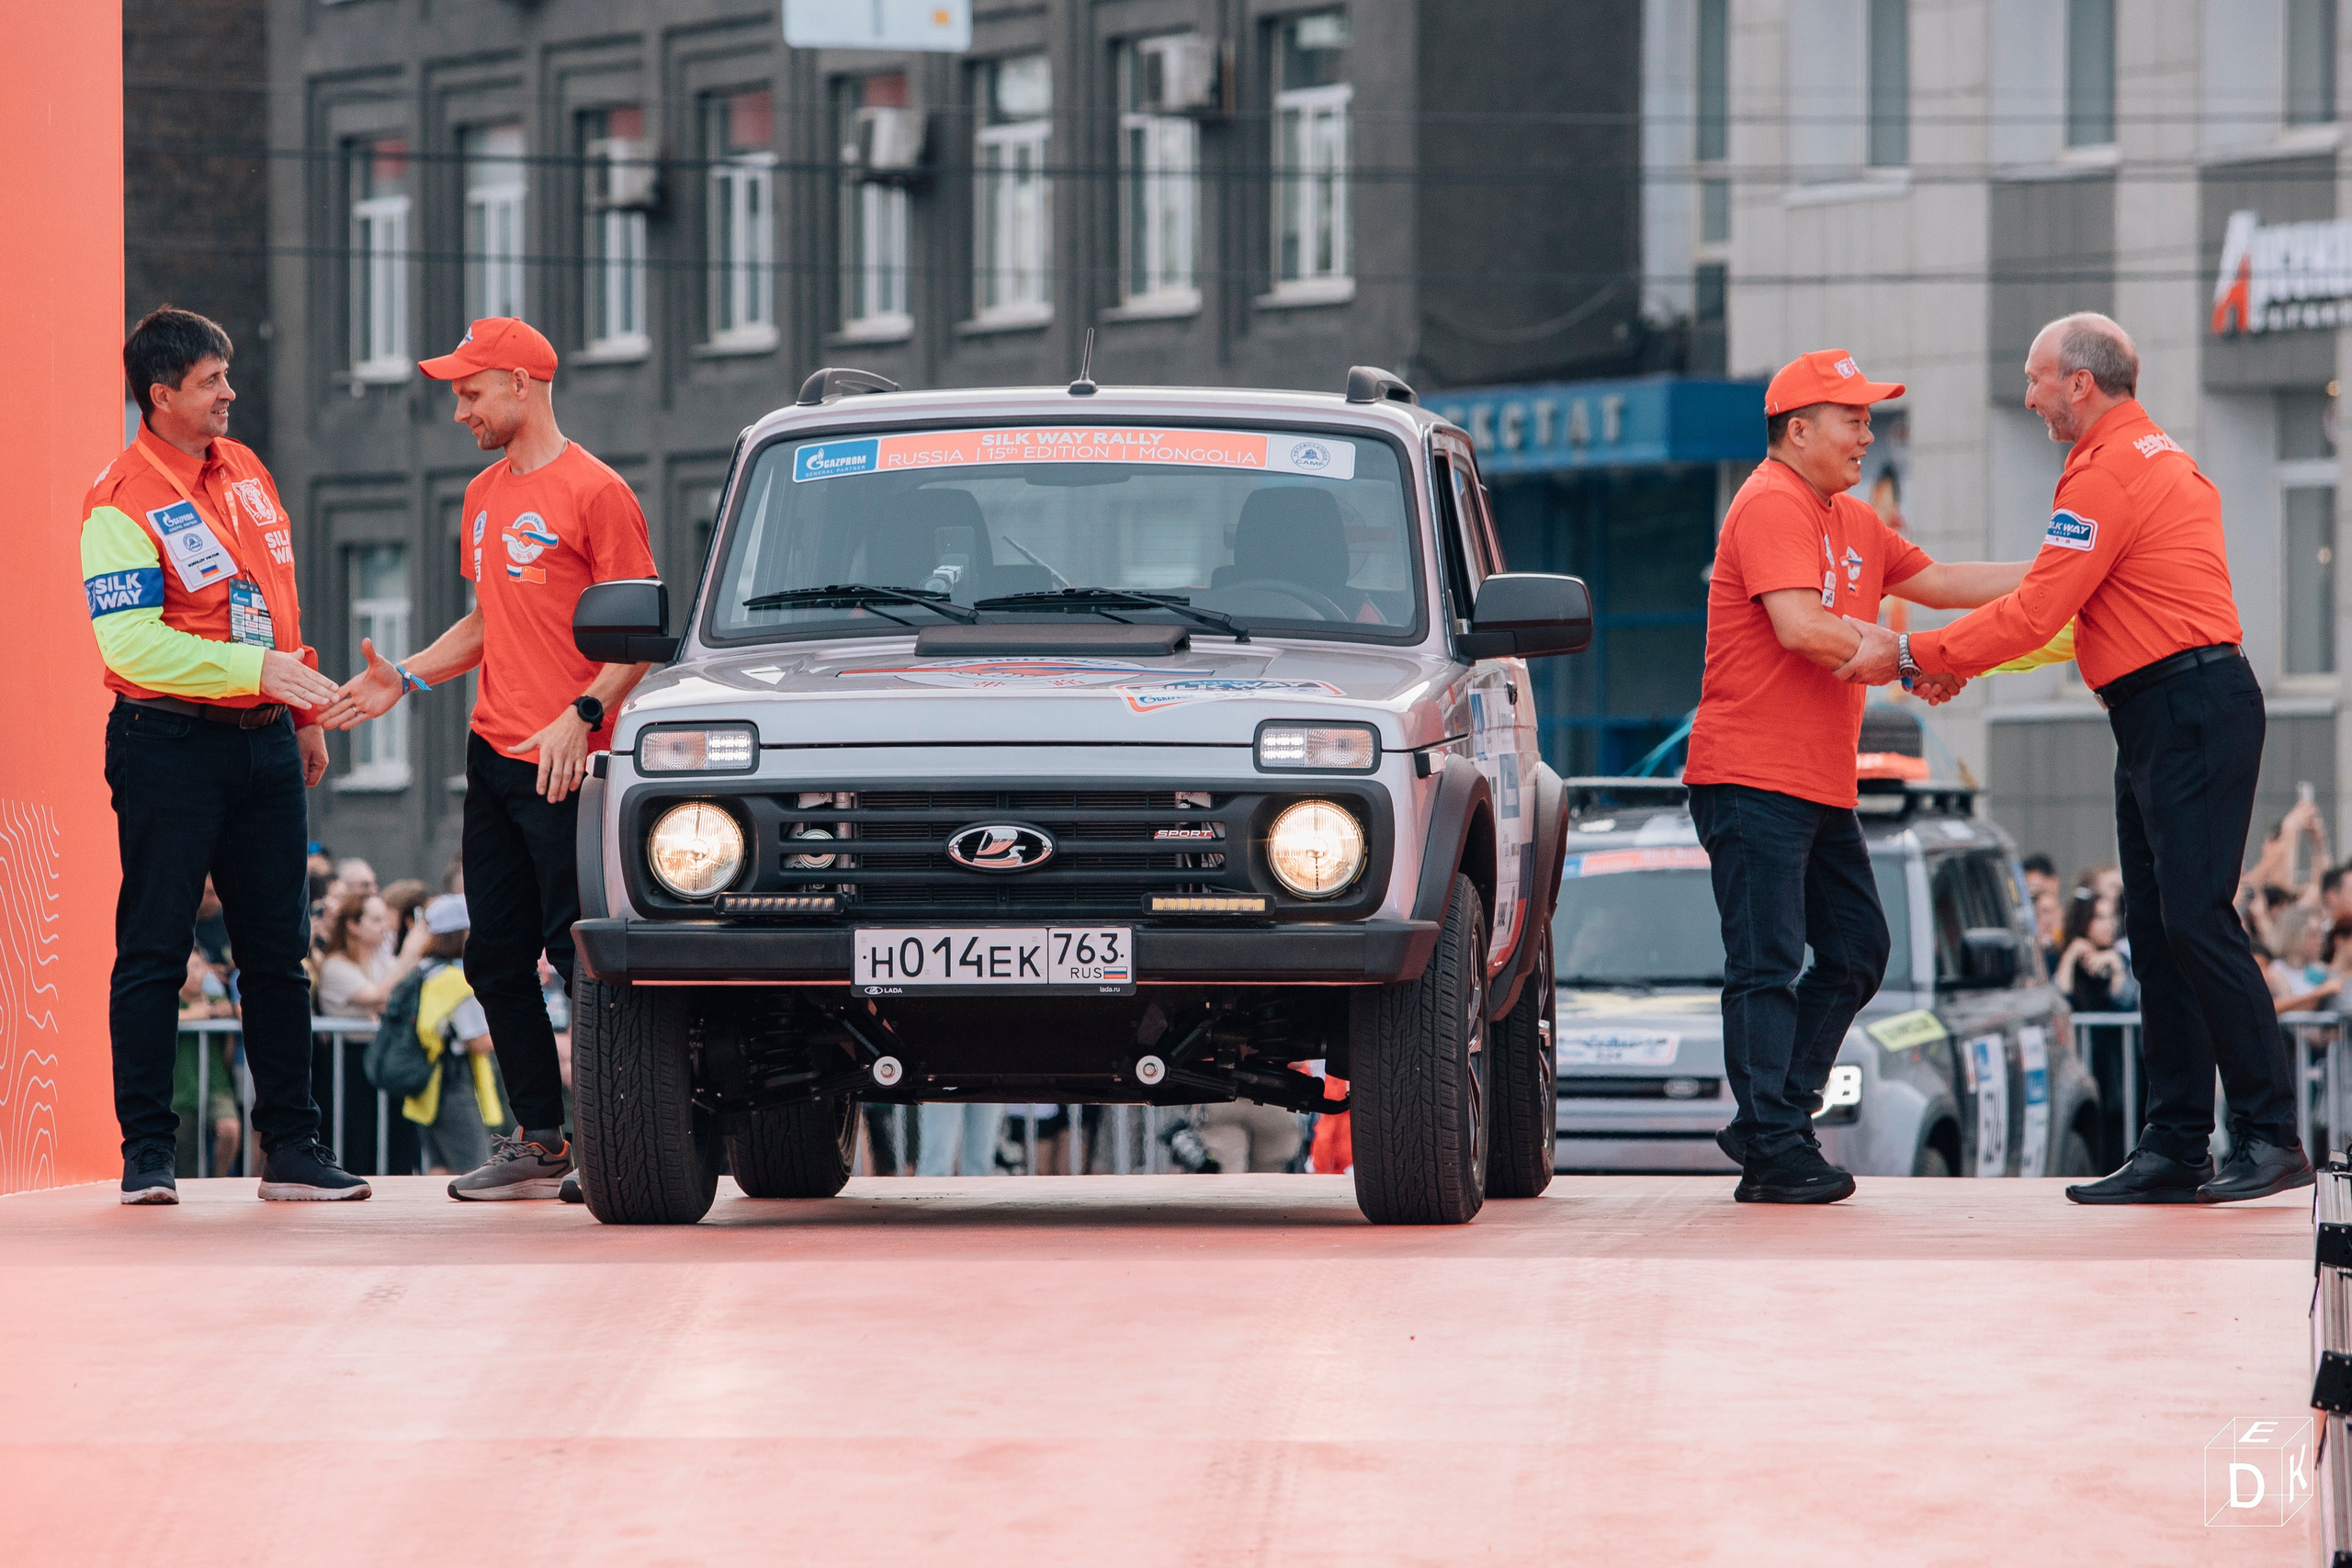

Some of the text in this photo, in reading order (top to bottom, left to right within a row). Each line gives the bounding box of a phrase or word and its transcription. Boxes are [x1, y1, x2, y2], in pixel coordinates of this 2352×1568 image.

[981, 432, 1165, 446] SILK WAY RALLY
[888, 451, 964, 468] RUSSIA
[987, 446, 1110, 460] 15th EDITION
[1139, 446, 1258, 465] MONGOLIA
[823, 455, 866, 468] GAZPROM
[805, 465, 866, 478] GENERAL PARTNER
[534, 516, 544, 531] RALLY
[2063, 523, 2090, 535] WAY
[95, 572, 142, 595] SILK
[96, 588, 142, 611] WAY
[1157, 829, 1214, 838] SPORT
[1053, 932, 1119, 964] 763
[1070, 967, 1102, 979] RUS
